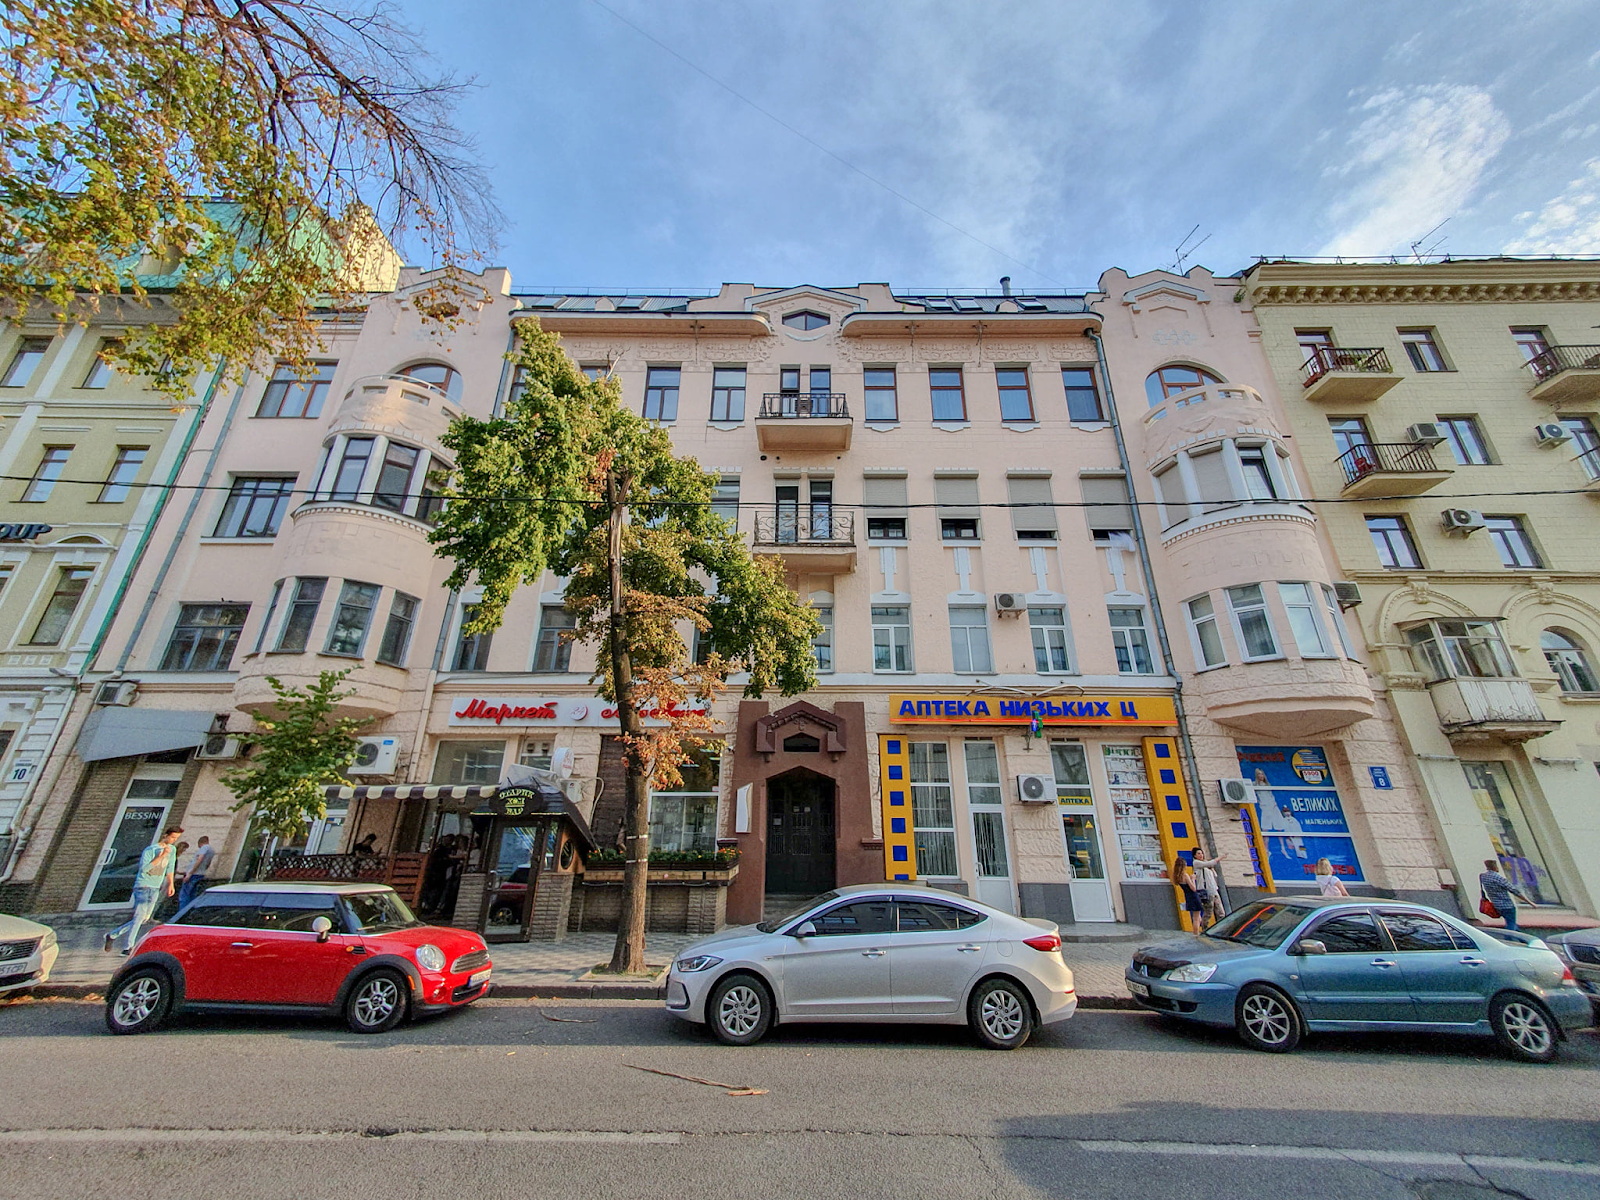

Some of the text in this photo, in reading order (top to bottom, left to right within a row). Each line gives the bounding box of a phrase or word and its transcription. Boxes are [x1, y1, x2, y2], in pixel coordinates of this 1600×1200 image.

[455, 698, 558, 725] Маркет
[899, 700, 1138, 719] АПТЕКА НИЗЬКИХ Ц
[13, 768, 27, 780] 10
[1378, 777, 1386, 787] 8
[1290, 797, 1339, 812] ВЕЛИКИХ
[1304, 818, 1344, 826] МАЛЕНЬКИХ
[1240, 808, 1268, 888] АПТЕКА
